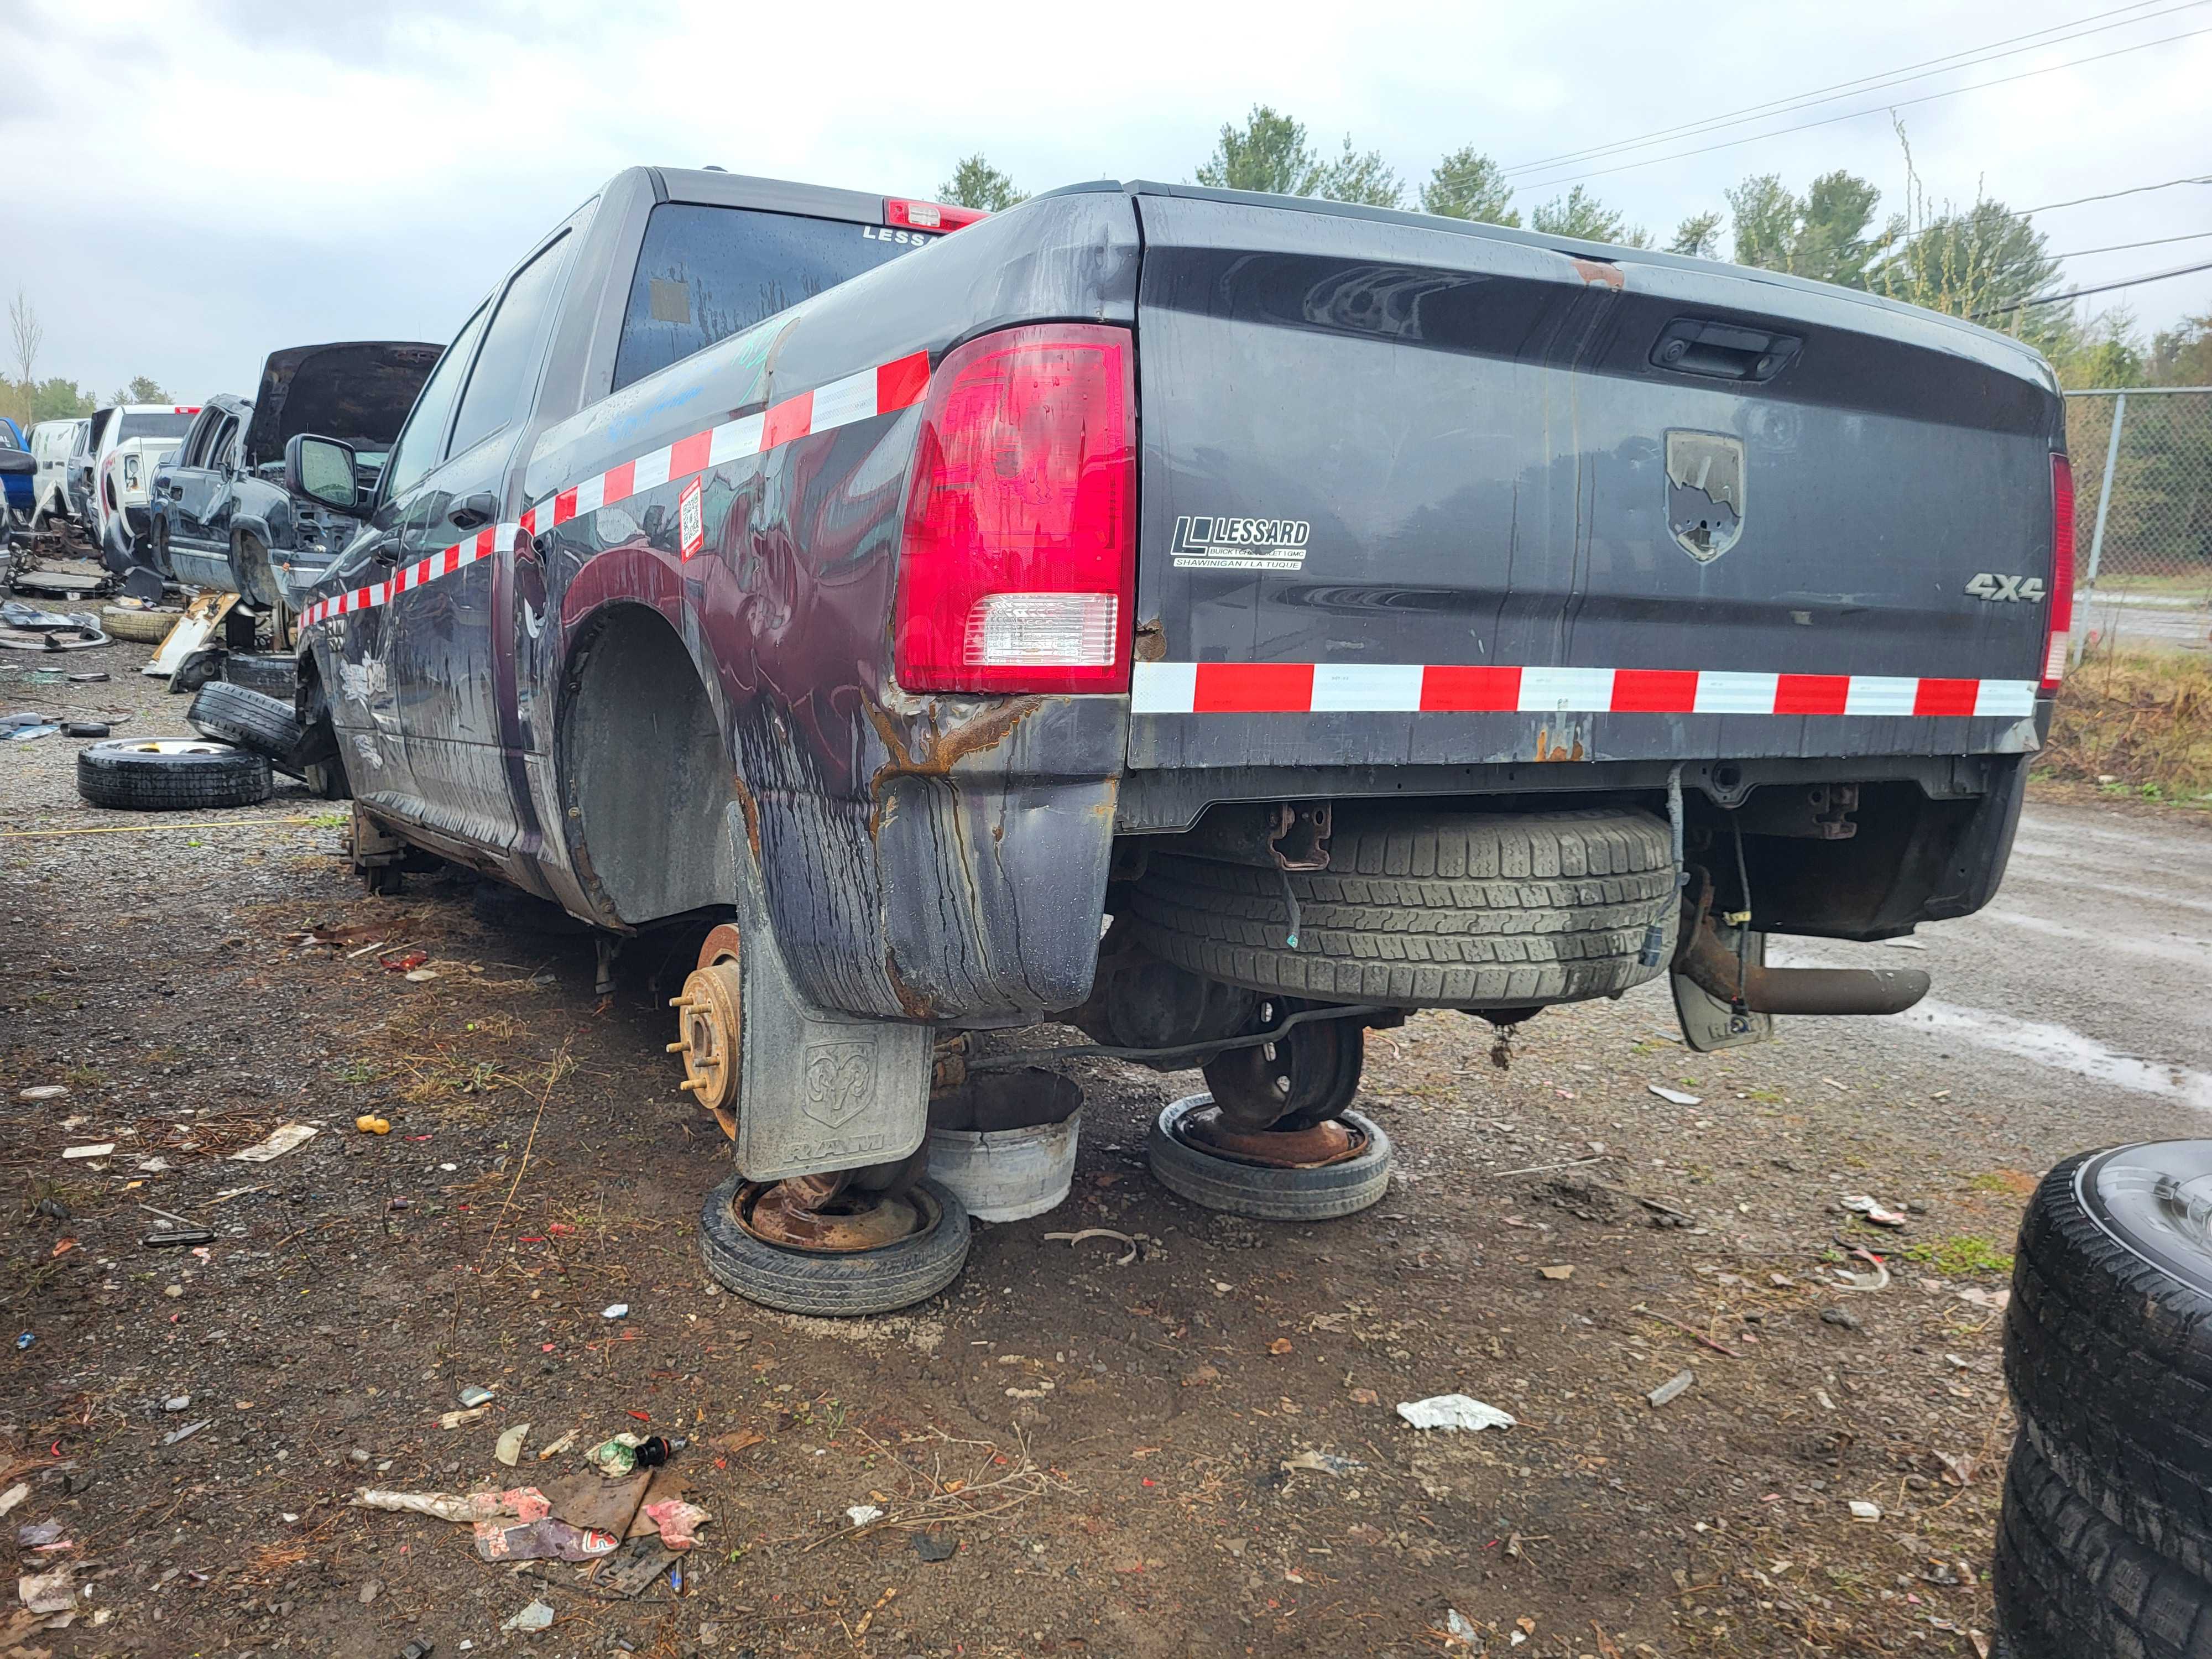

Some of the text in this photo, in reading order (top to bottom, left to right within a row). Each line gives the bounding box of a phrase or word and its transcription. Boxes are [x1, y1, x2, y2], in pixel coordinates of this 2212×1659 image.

[1213, 517, 1310, 546] LESSARD
[1176, 559, 1242, 567] SHAWINIGAN
[783, 1133, 884, 1164] RAM
